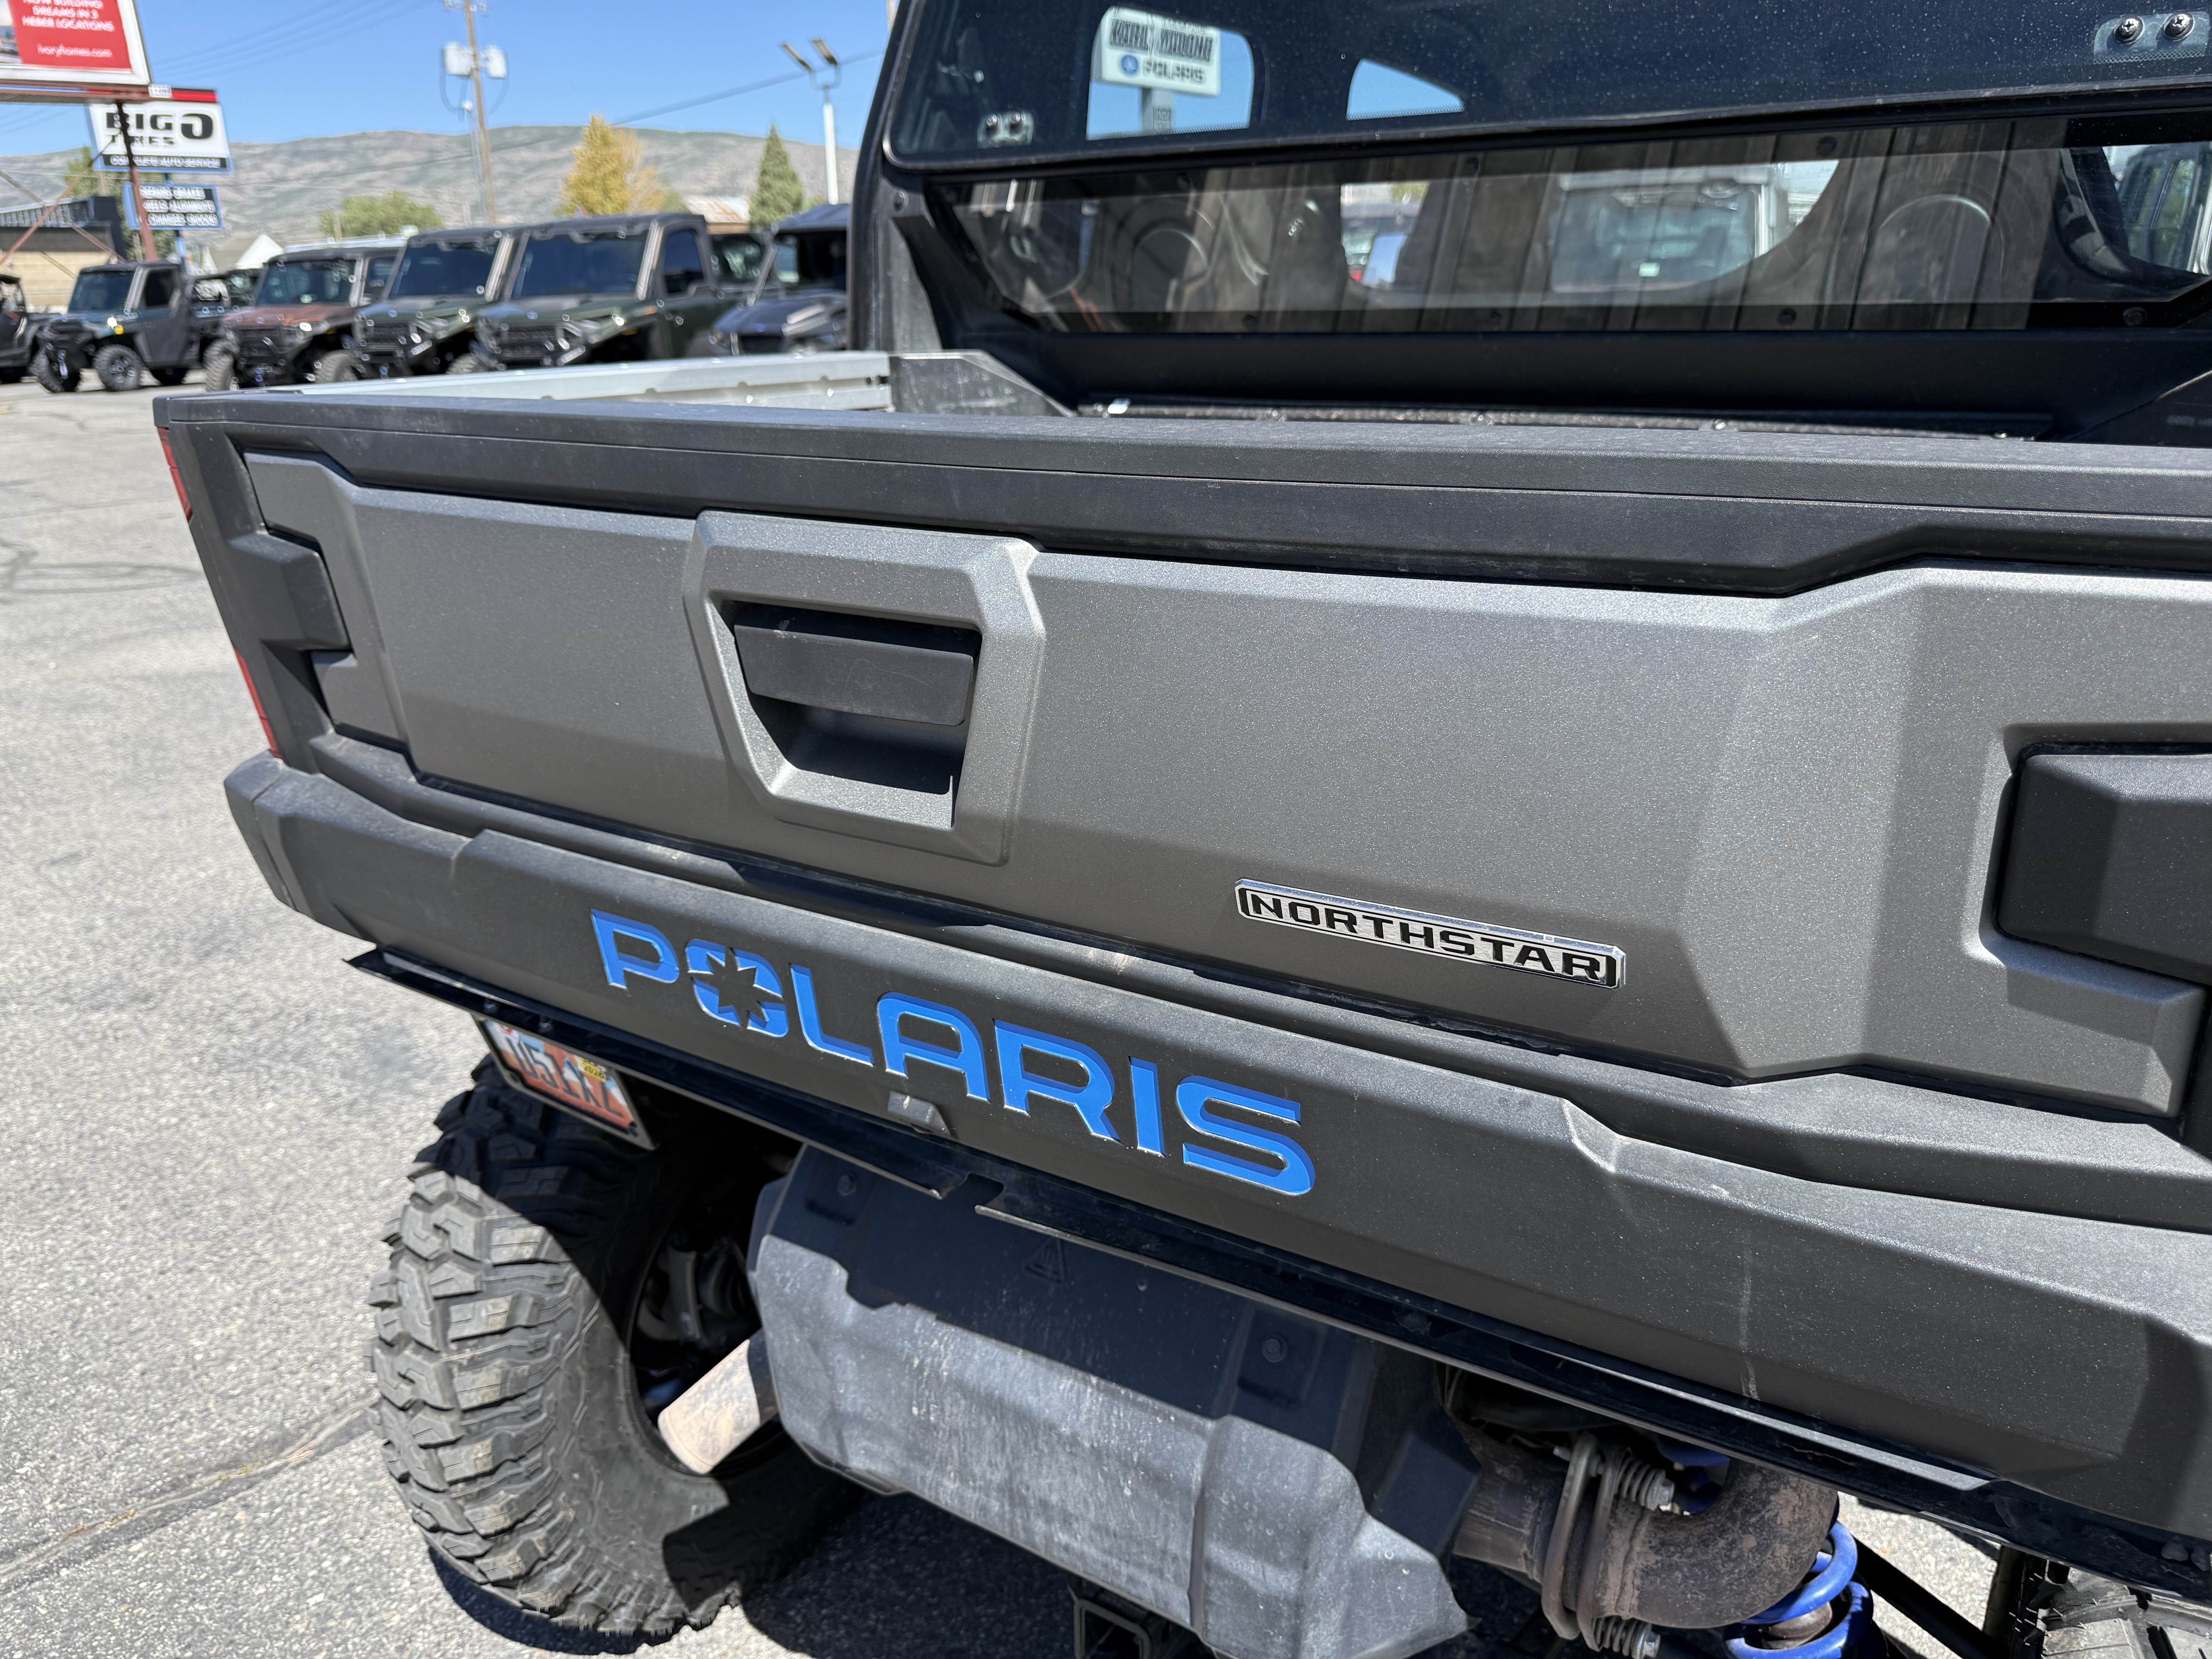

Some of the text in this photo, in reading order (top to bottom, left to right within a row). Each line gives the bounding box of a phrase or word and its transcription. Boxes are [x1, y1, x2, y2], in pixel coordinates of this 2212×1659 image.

[32, 5, 99, 19] DREAMS IN 3
[22, 16, 115, 32] HEBER LOCATIONS
[37, 43, 113, 57] ivoryhomes.com
[1251, 894, 1600, 981] NORTHSTAR
[589, 908, 1316, 1195] POLARIS
